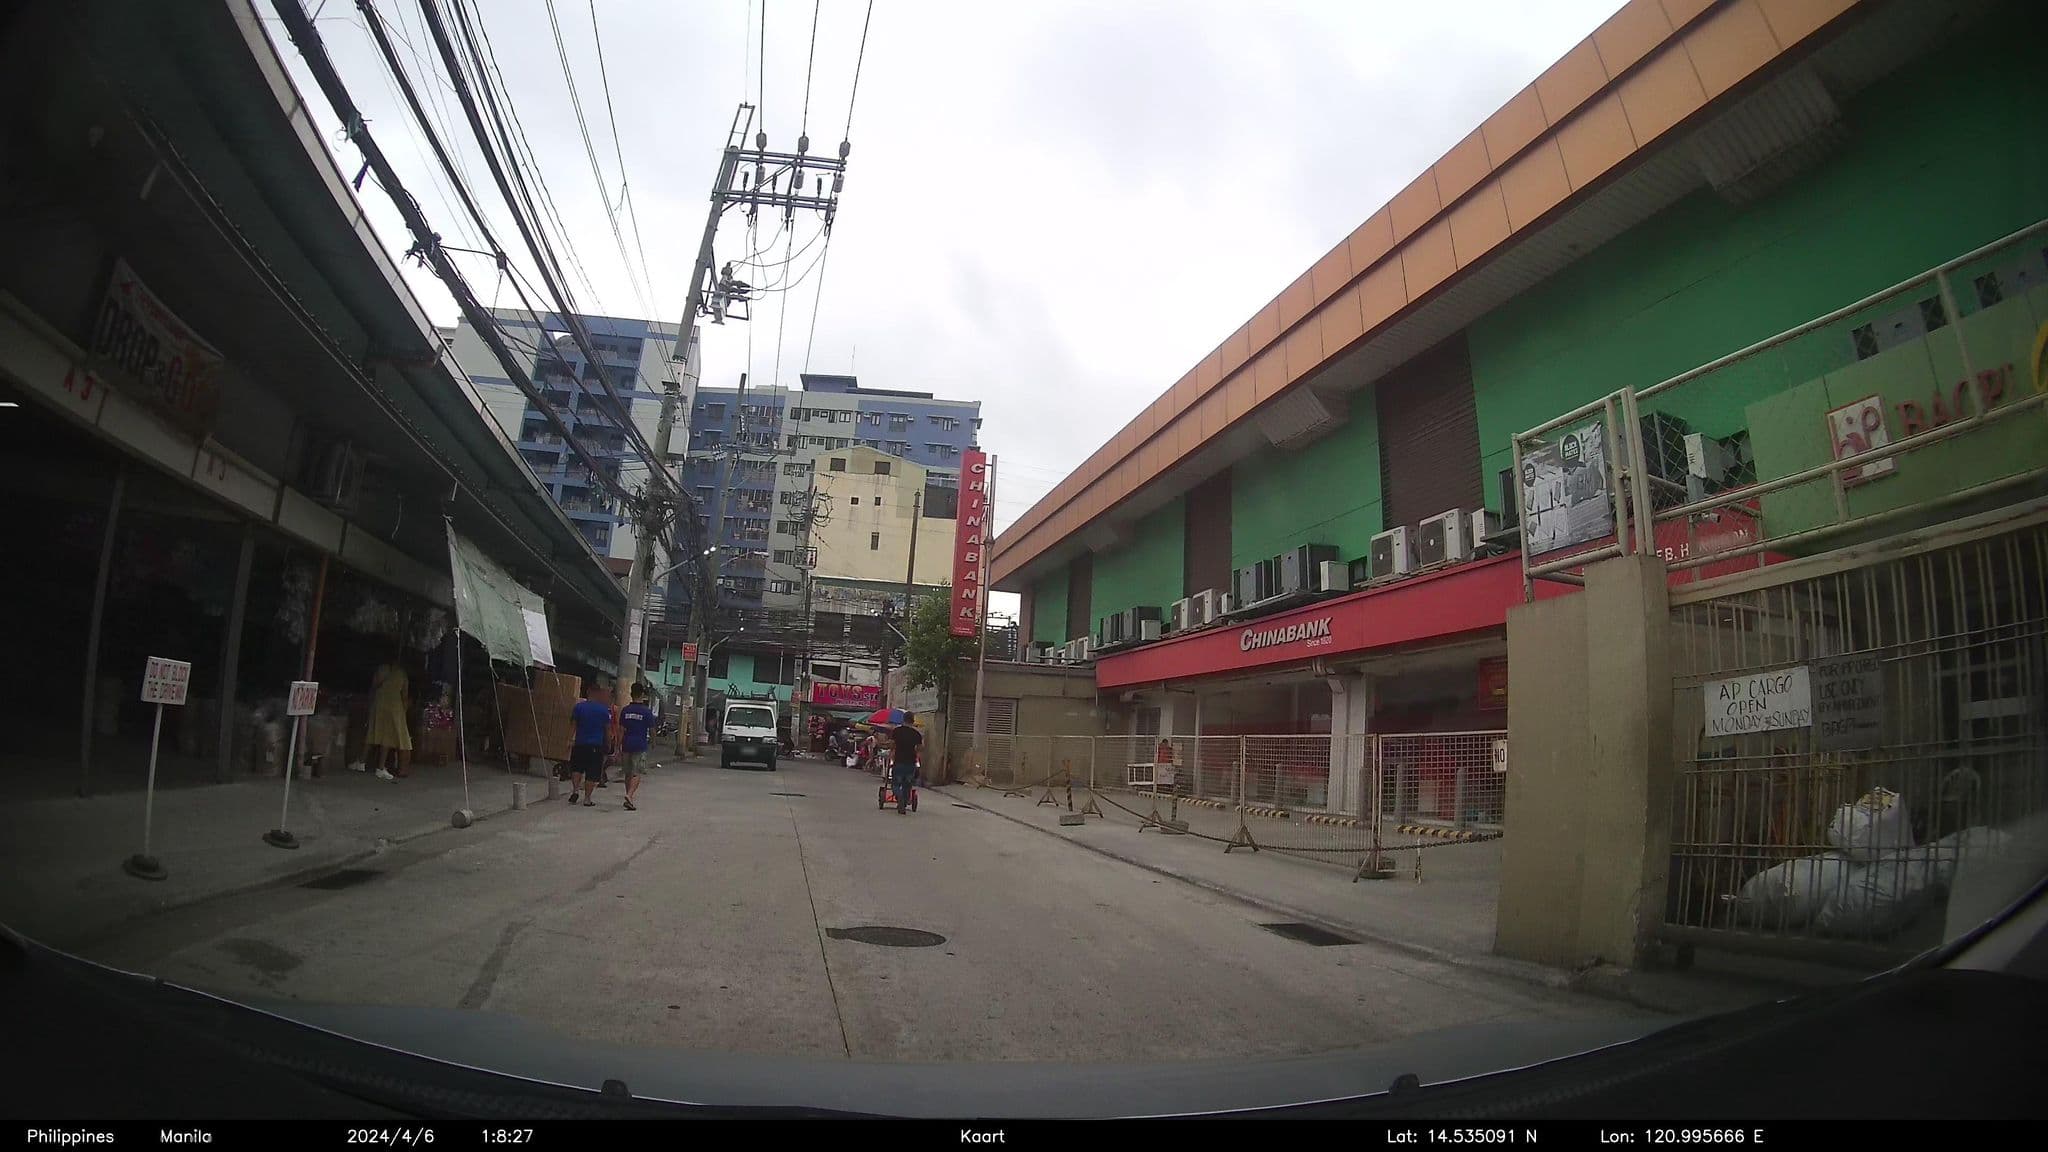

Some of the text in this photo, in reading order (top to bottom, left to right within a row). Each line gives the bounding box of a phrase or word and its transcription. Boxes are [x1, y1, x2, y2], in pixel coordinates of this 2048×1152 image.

[959, 463, 985, 619] CHINABANK
[1240, 617, 1333, 651] CHINABANK
[817, 684, 863, 700] TOYS
[1720, 675, 1793, 700] AP CARGO
[1726, 697, 1767, 716] OPEN
[1712, 714, 1761, 733] MONDAY
[1495, 748, 1505, 763] NO
